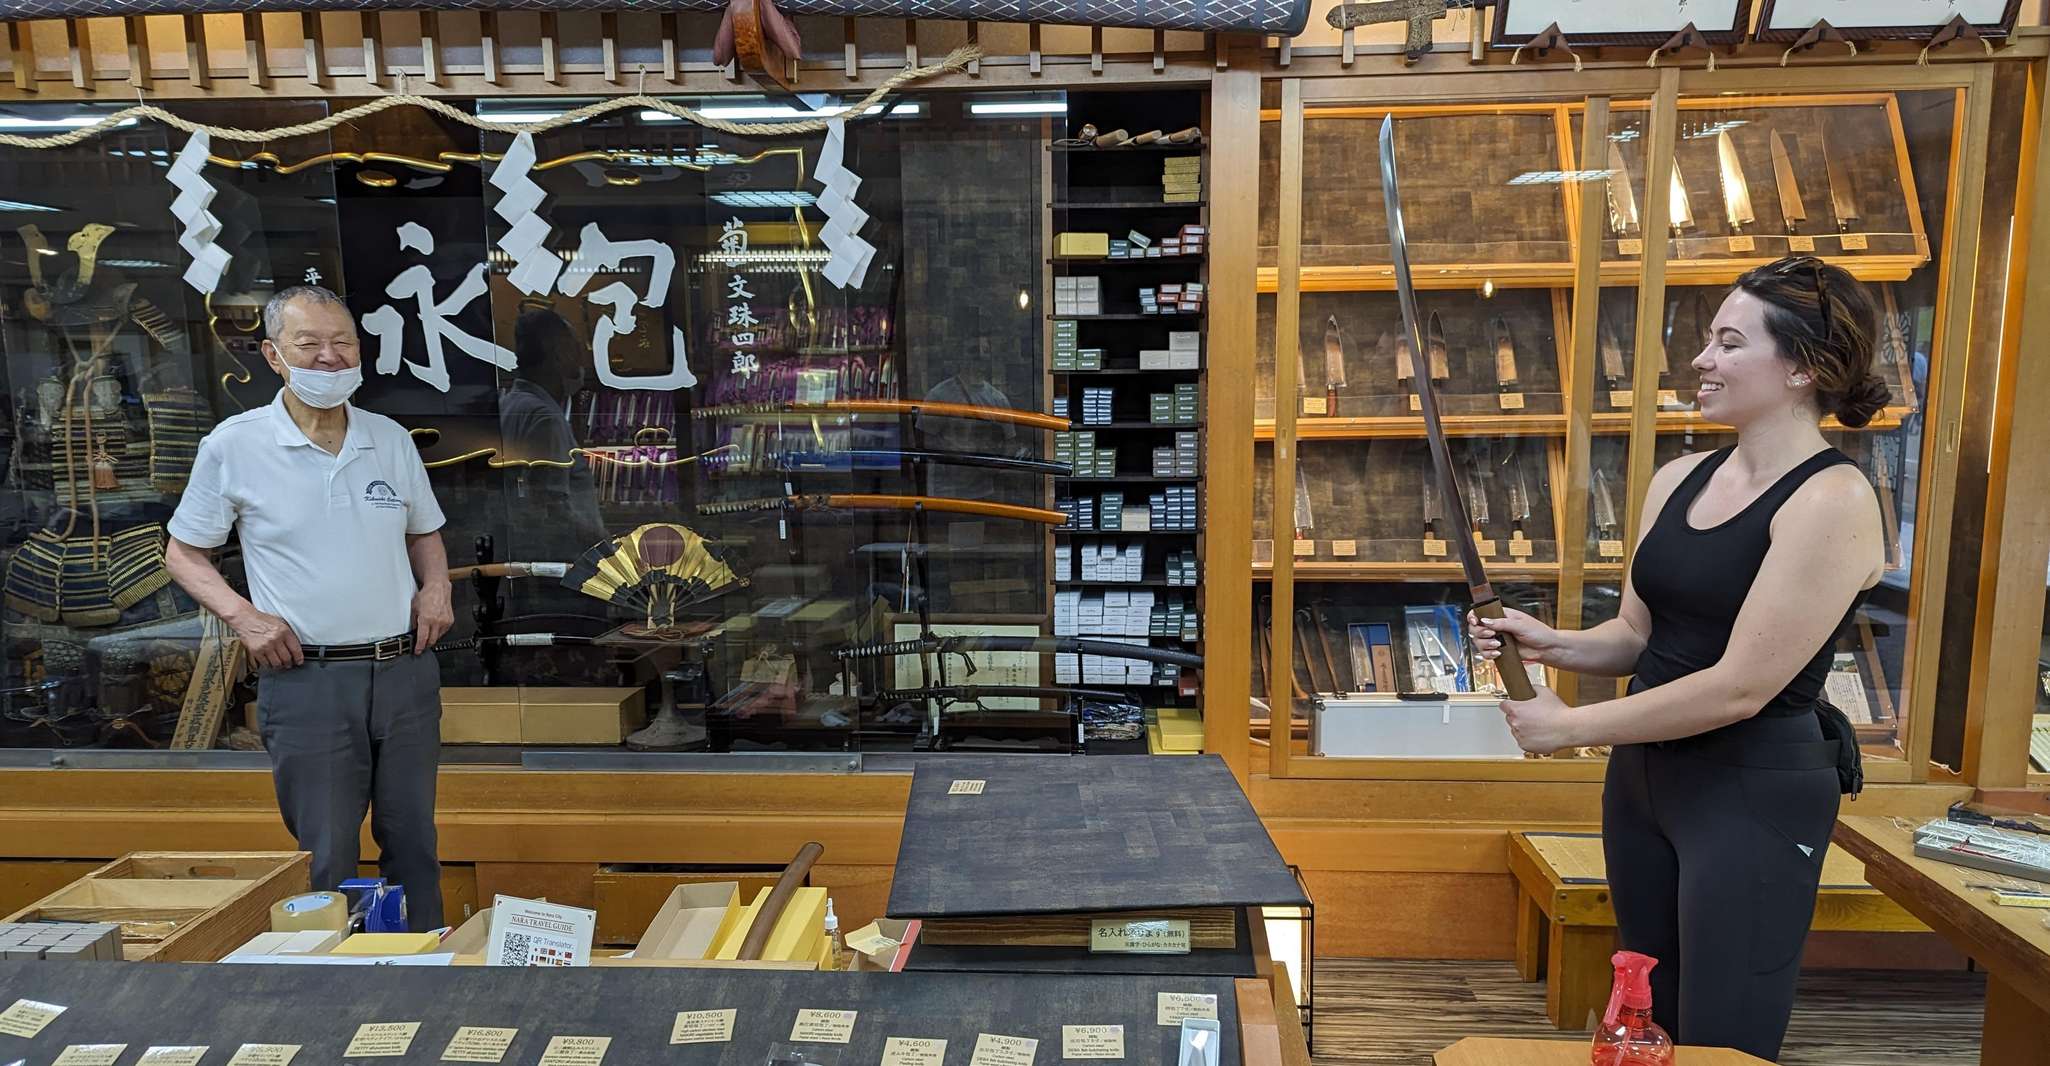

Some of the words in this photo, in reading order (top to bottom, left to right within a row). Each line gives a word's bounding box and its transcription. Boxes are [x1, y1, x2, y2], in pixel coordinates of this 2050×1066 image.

[512, 916, 528, 925] NARA
[530, 918, 552, 929] TRAVEL
[553, 922, 572, 932] GUIDE
[991, 1036, 1021, 1046] ¥4,900
